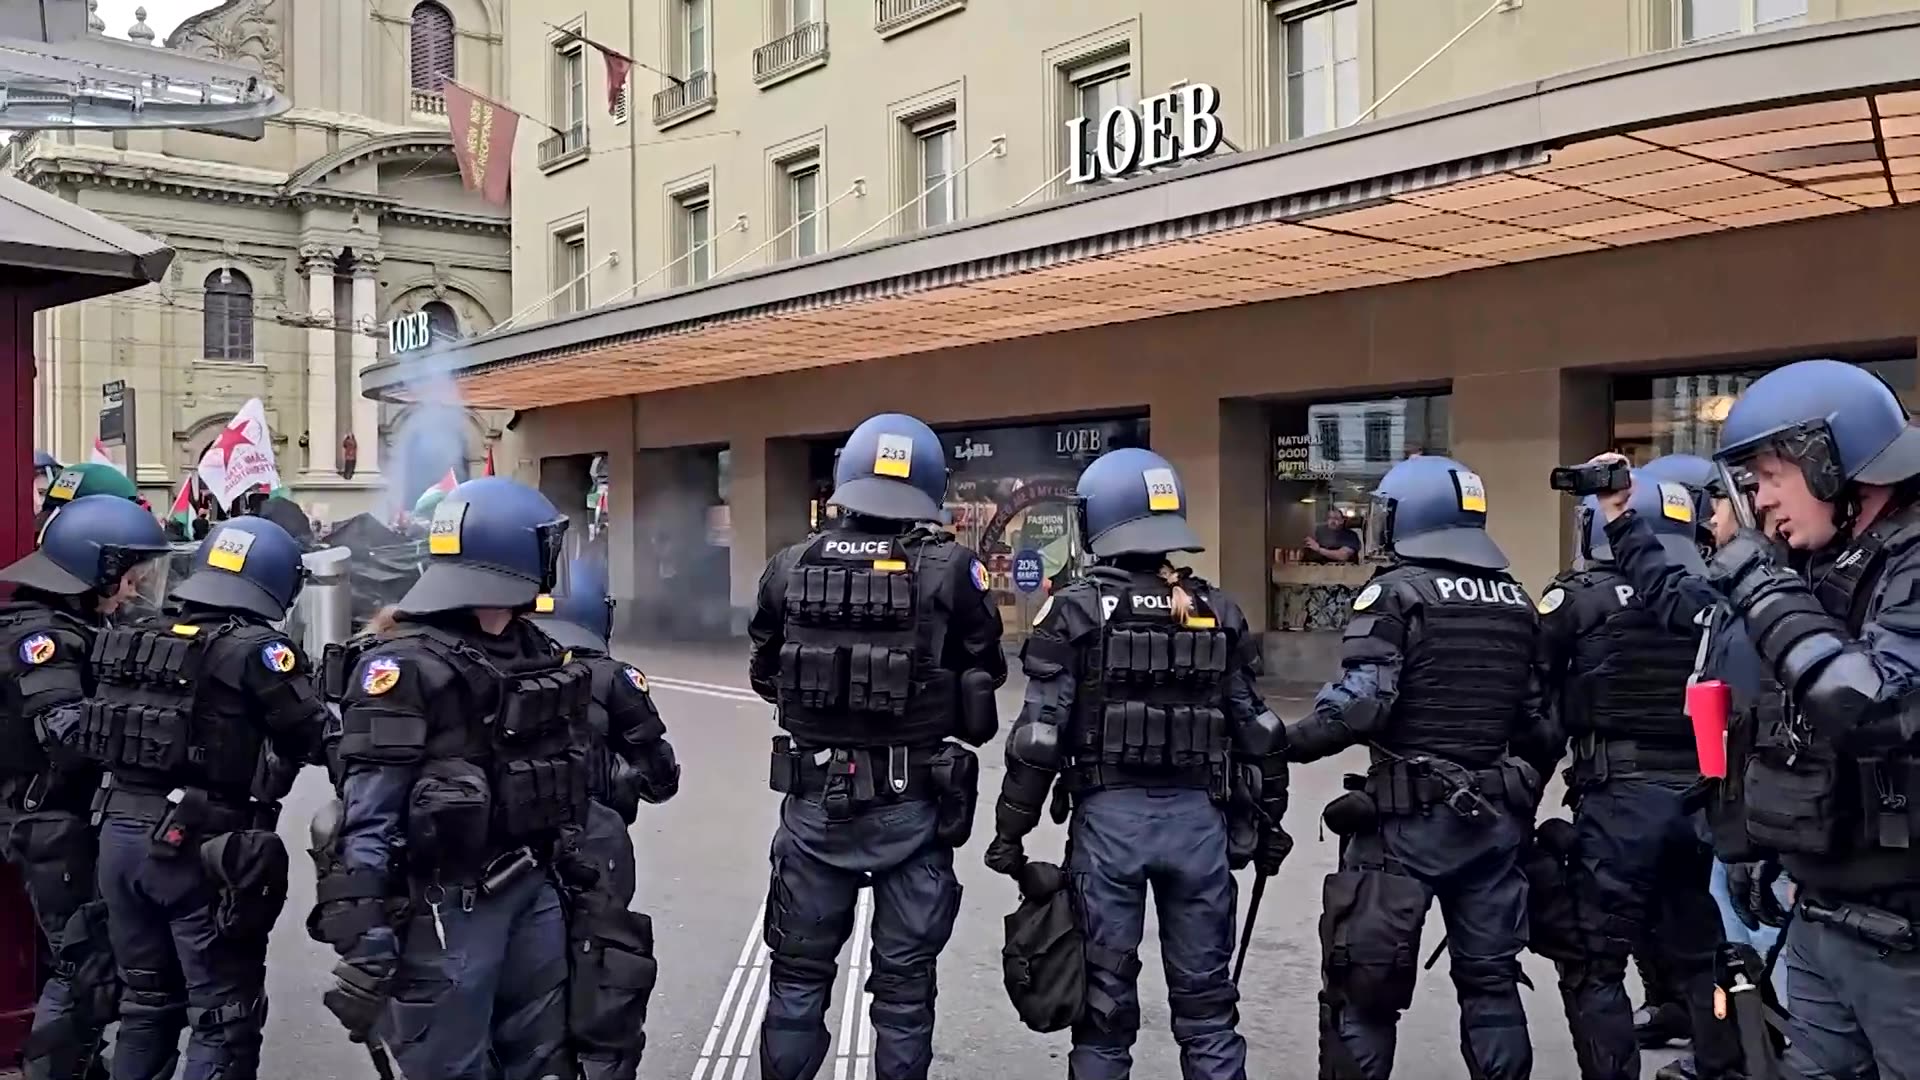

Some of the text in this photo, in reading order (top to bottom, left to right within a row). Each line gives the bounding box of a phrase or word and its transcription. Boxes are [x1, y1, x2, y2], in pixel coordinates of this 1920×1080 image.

[1065, 82, 1222, 185] LOEB
[388, 311, 429, 354] LOEB
[1056, 429, 1101, 453] LOEB
[1277, 433, 1323, 446] NATURAL
[881, 447, 906, 460] 233
[1278, 447, 1308, 459] GOOD
[1026, 515, 1064, 525] FASHION
[218, 539, 245, 555] 232
[825, 541, 889, 555] POLICE
[1017, 559, 1039, 571] 20%
[1436, 576, 1528, 607] POLICE
[1132, 595, 1173, 609] POLI
